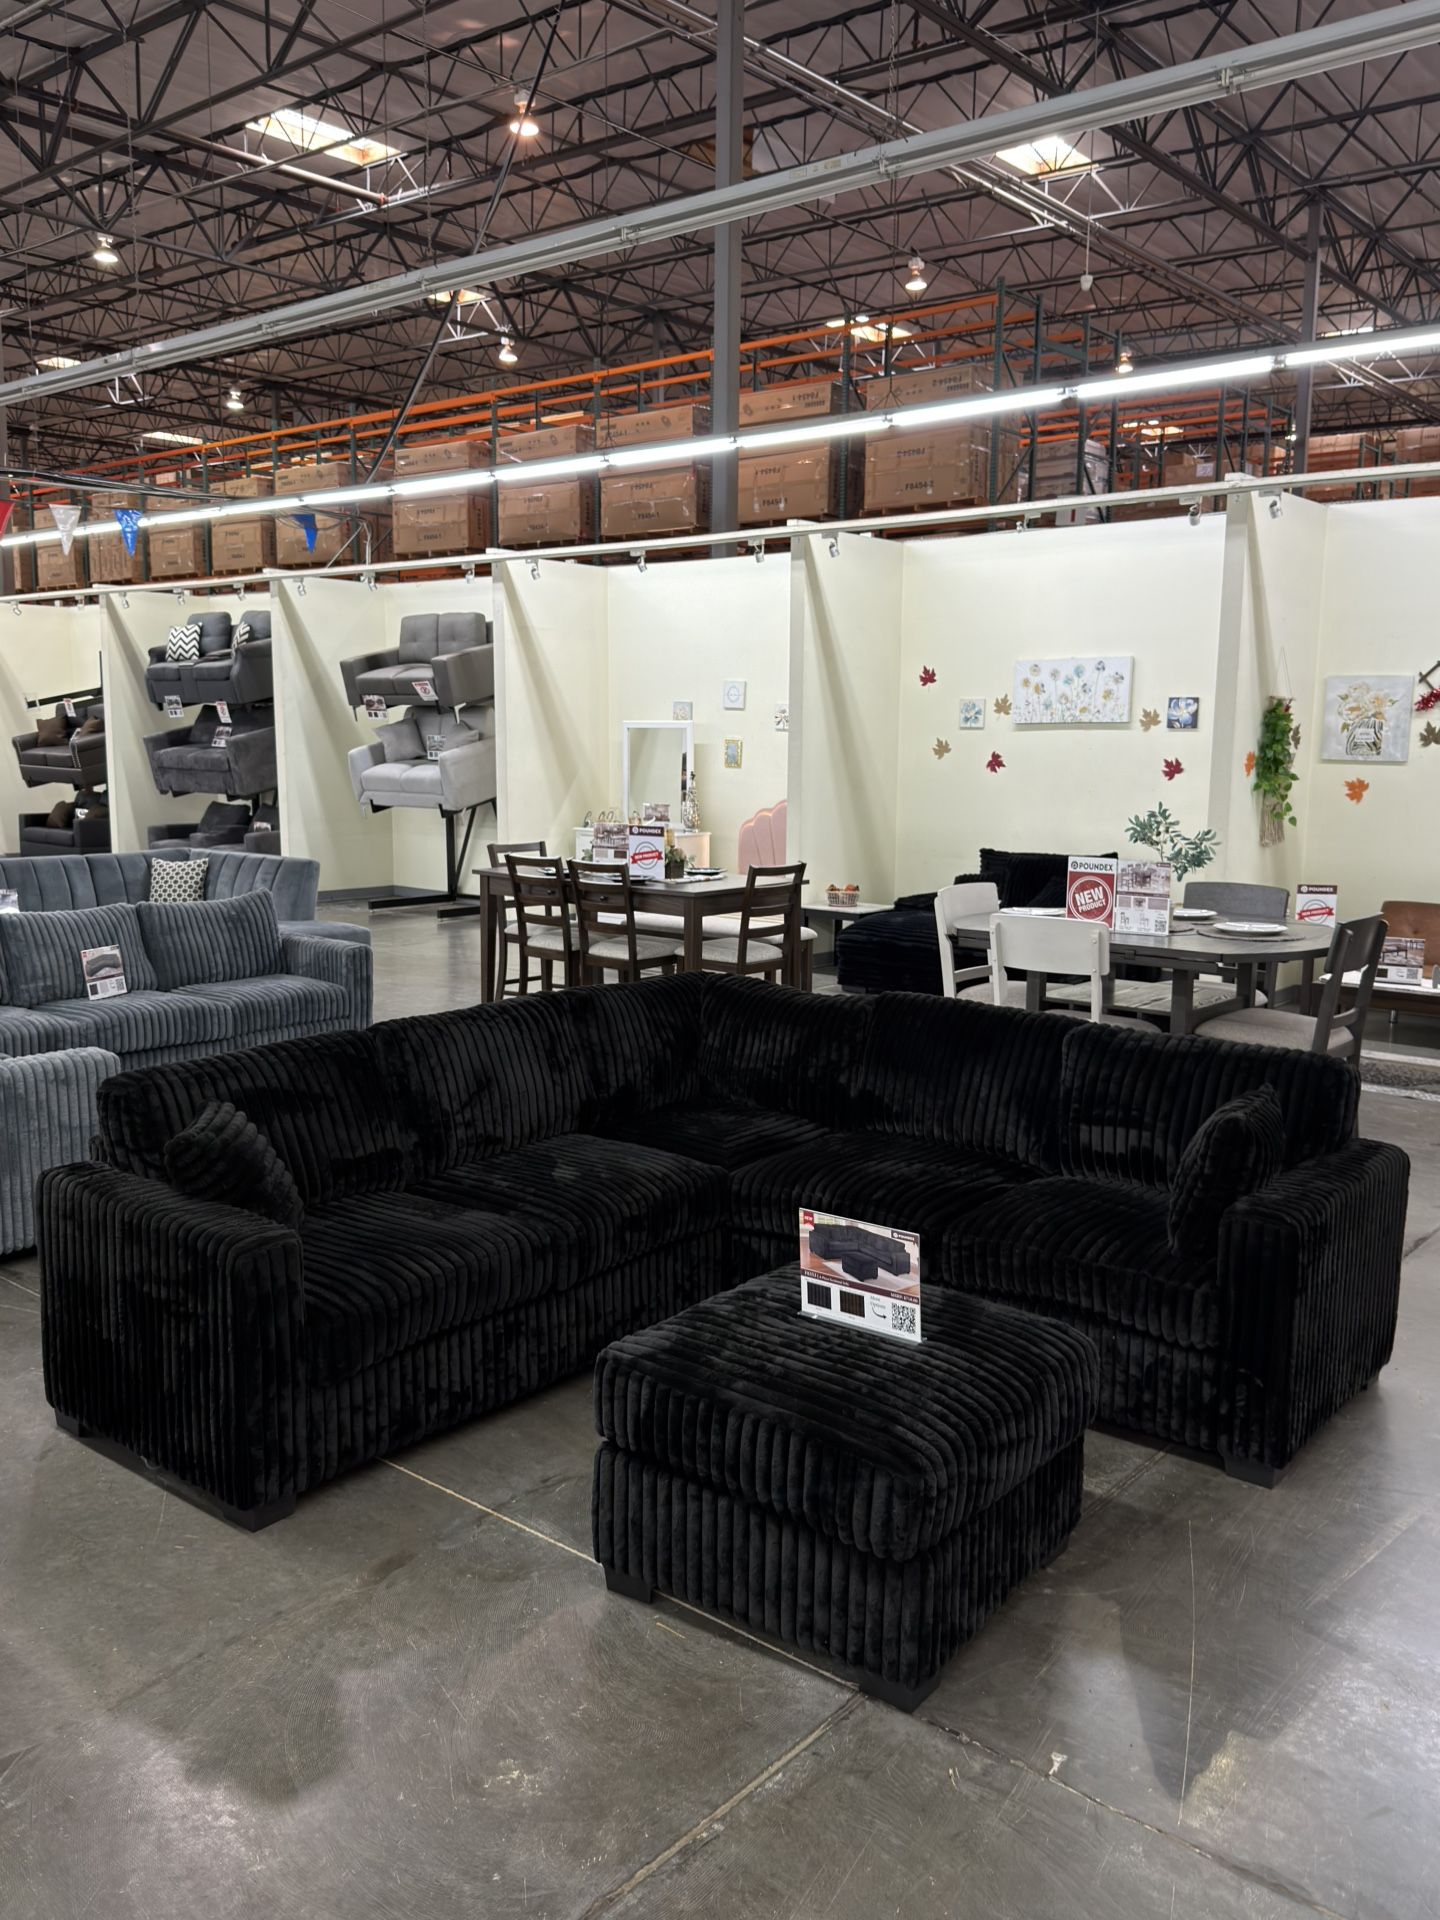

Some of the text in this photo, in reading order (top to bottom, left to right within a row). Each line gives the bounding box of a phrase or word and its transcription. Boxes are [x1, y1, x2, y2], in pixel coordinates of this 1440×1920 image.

[1078, 862, 1113, 871] POUNDEX
[1075, 886, 1104, 906] NEW
[1079, 898, 1106, 912] PRODUCT
